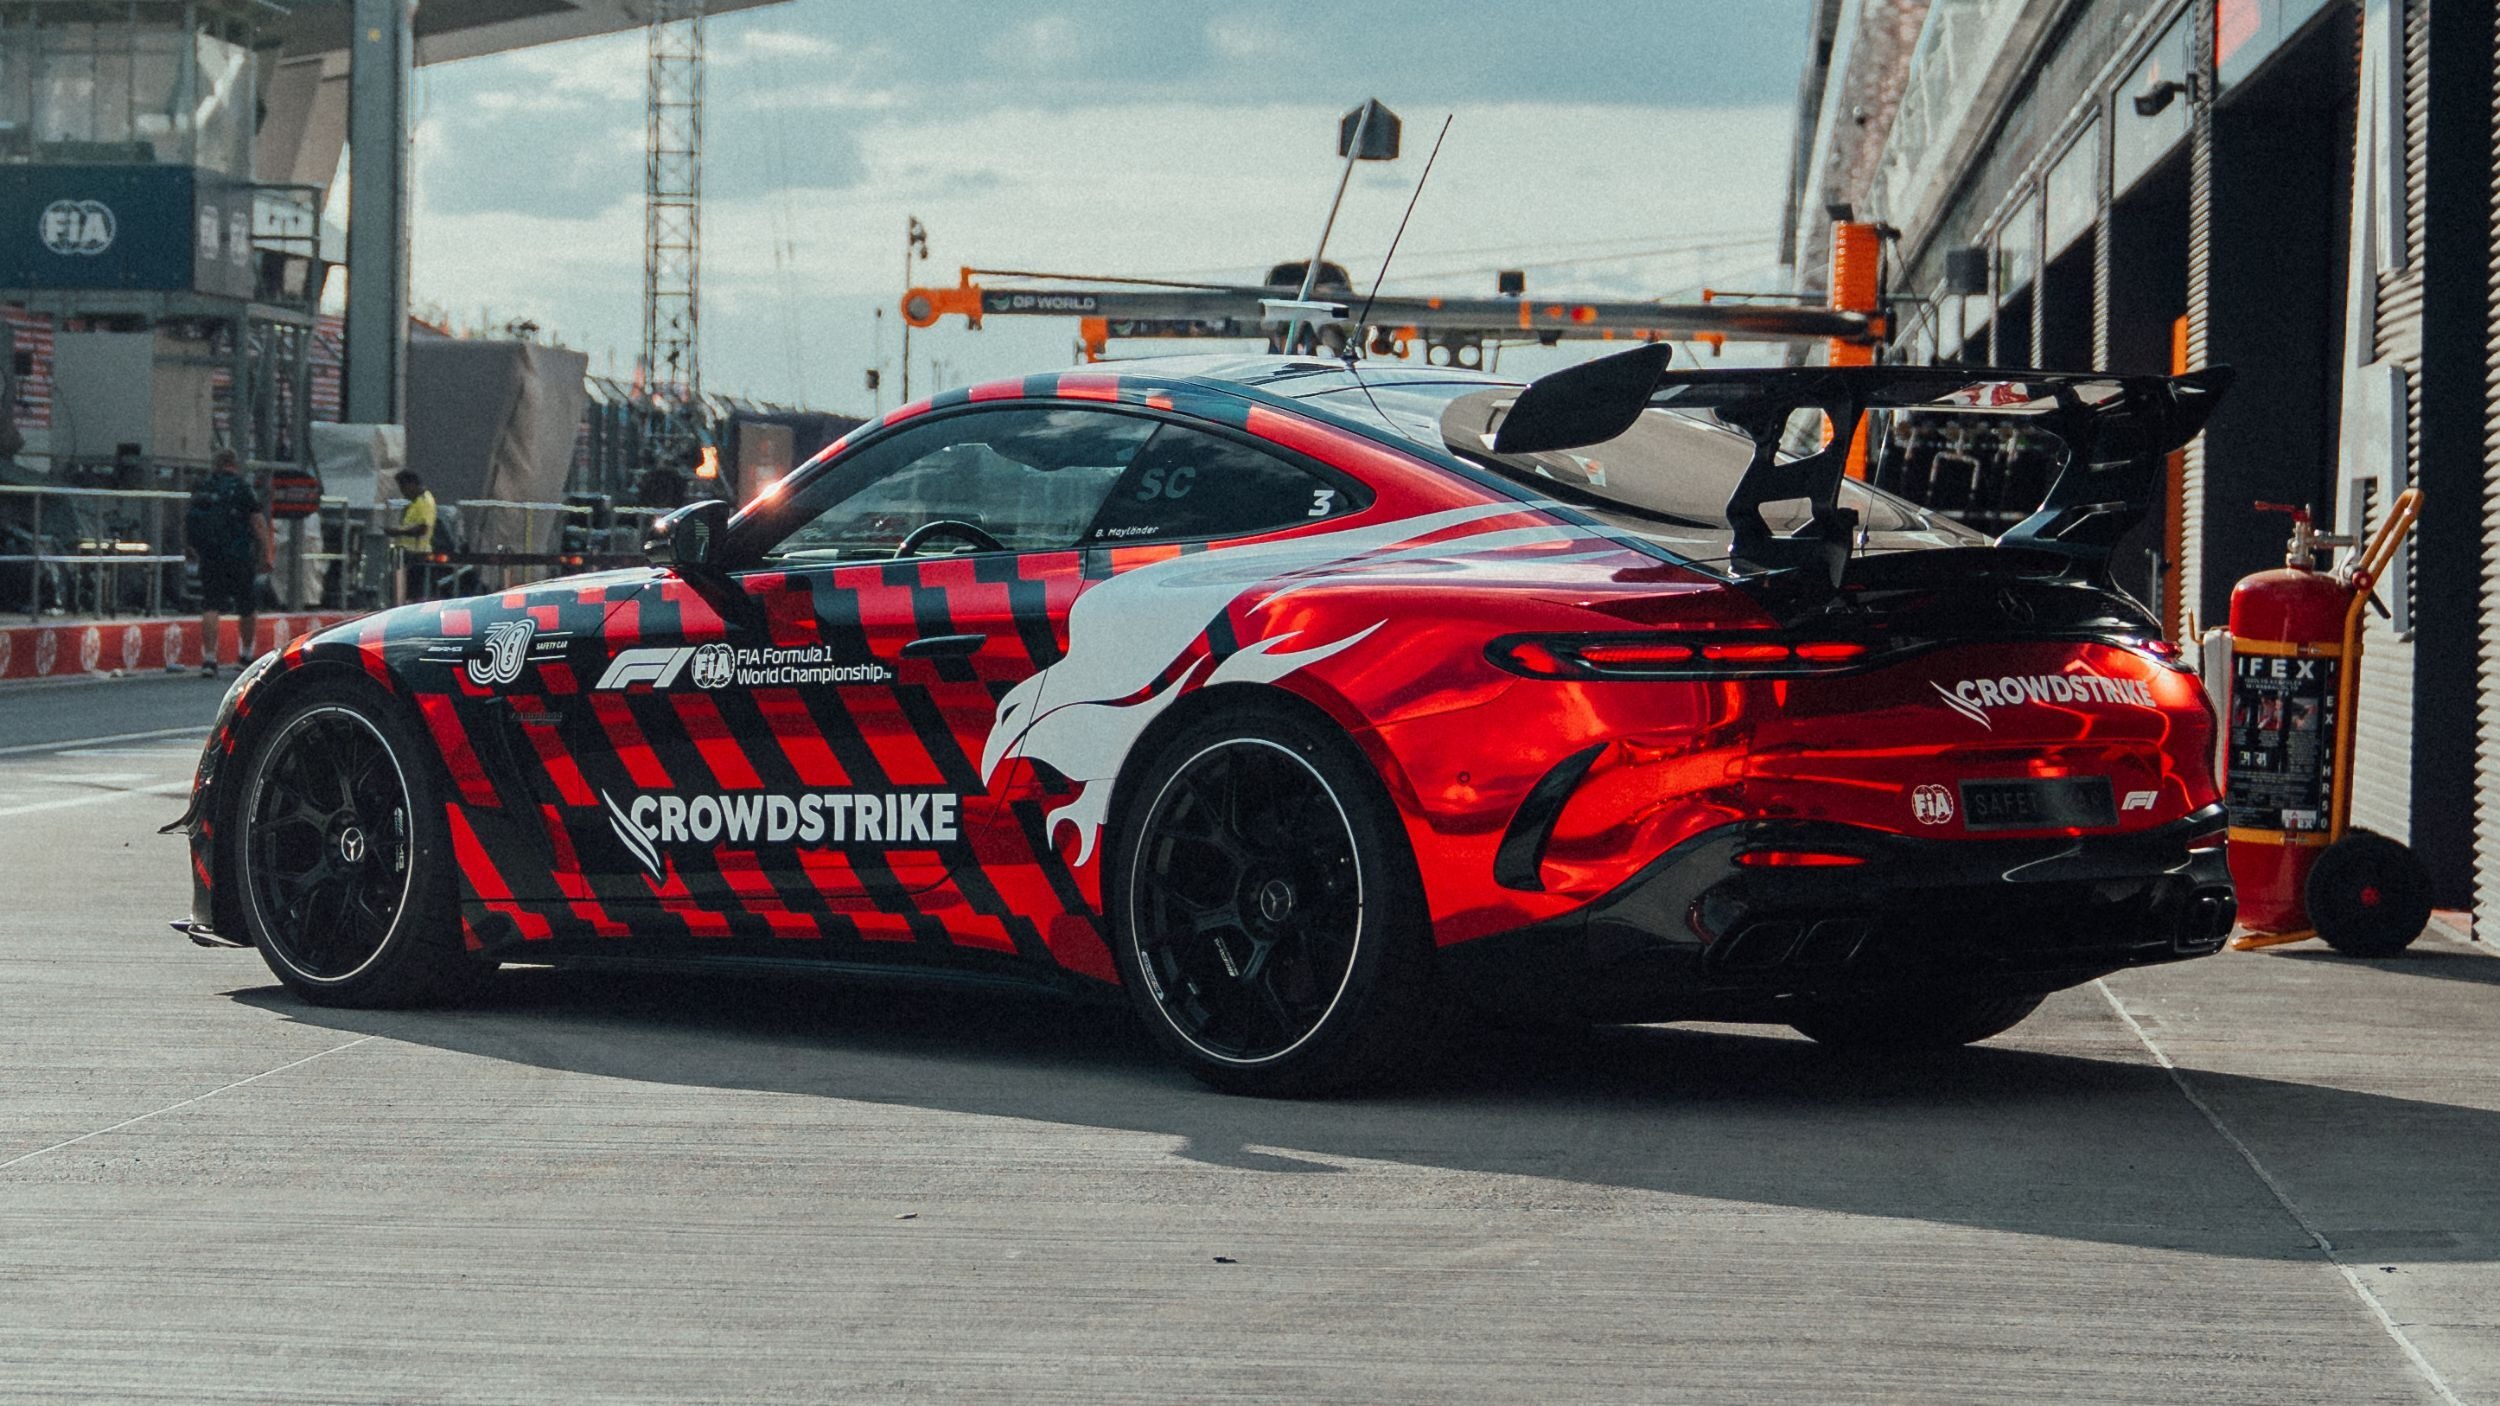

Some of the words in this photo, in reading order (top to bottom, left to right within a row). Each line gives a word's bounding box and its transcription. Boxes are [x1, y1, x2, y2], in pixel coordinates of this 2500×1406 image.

[1013, 296, 1035, 308] DP
[1038, 296, 1095, 310] WORLD
[1136, 466, 1196, 501] SC
[1308, 490, 1335, 516] 3
[1095, 529, 1104, 538] B.
[1108, 526, 1159, 538] Mayländer
[468, 618, 536, 684] 30
[536, 641, 556, 650] SAFETY
[556, 641, 568, 649] CAR
[737, 649, 760, 664] FIA
[763, 647, 820, 664] Formula
[824, 645, 833, 662] 1
[595, 647, 697, 688] F1
[738, 667, 778, 684] World
[2238, 656, 2314, 679] IFEX
[1955, 675, 2157, 708] CROWDSTRIKE
[1974, 789, 2050, 816] SAFET
[2121, 791, 2159, 811] F1
[630, 794, 958, 843] CROWDSTRIKE
